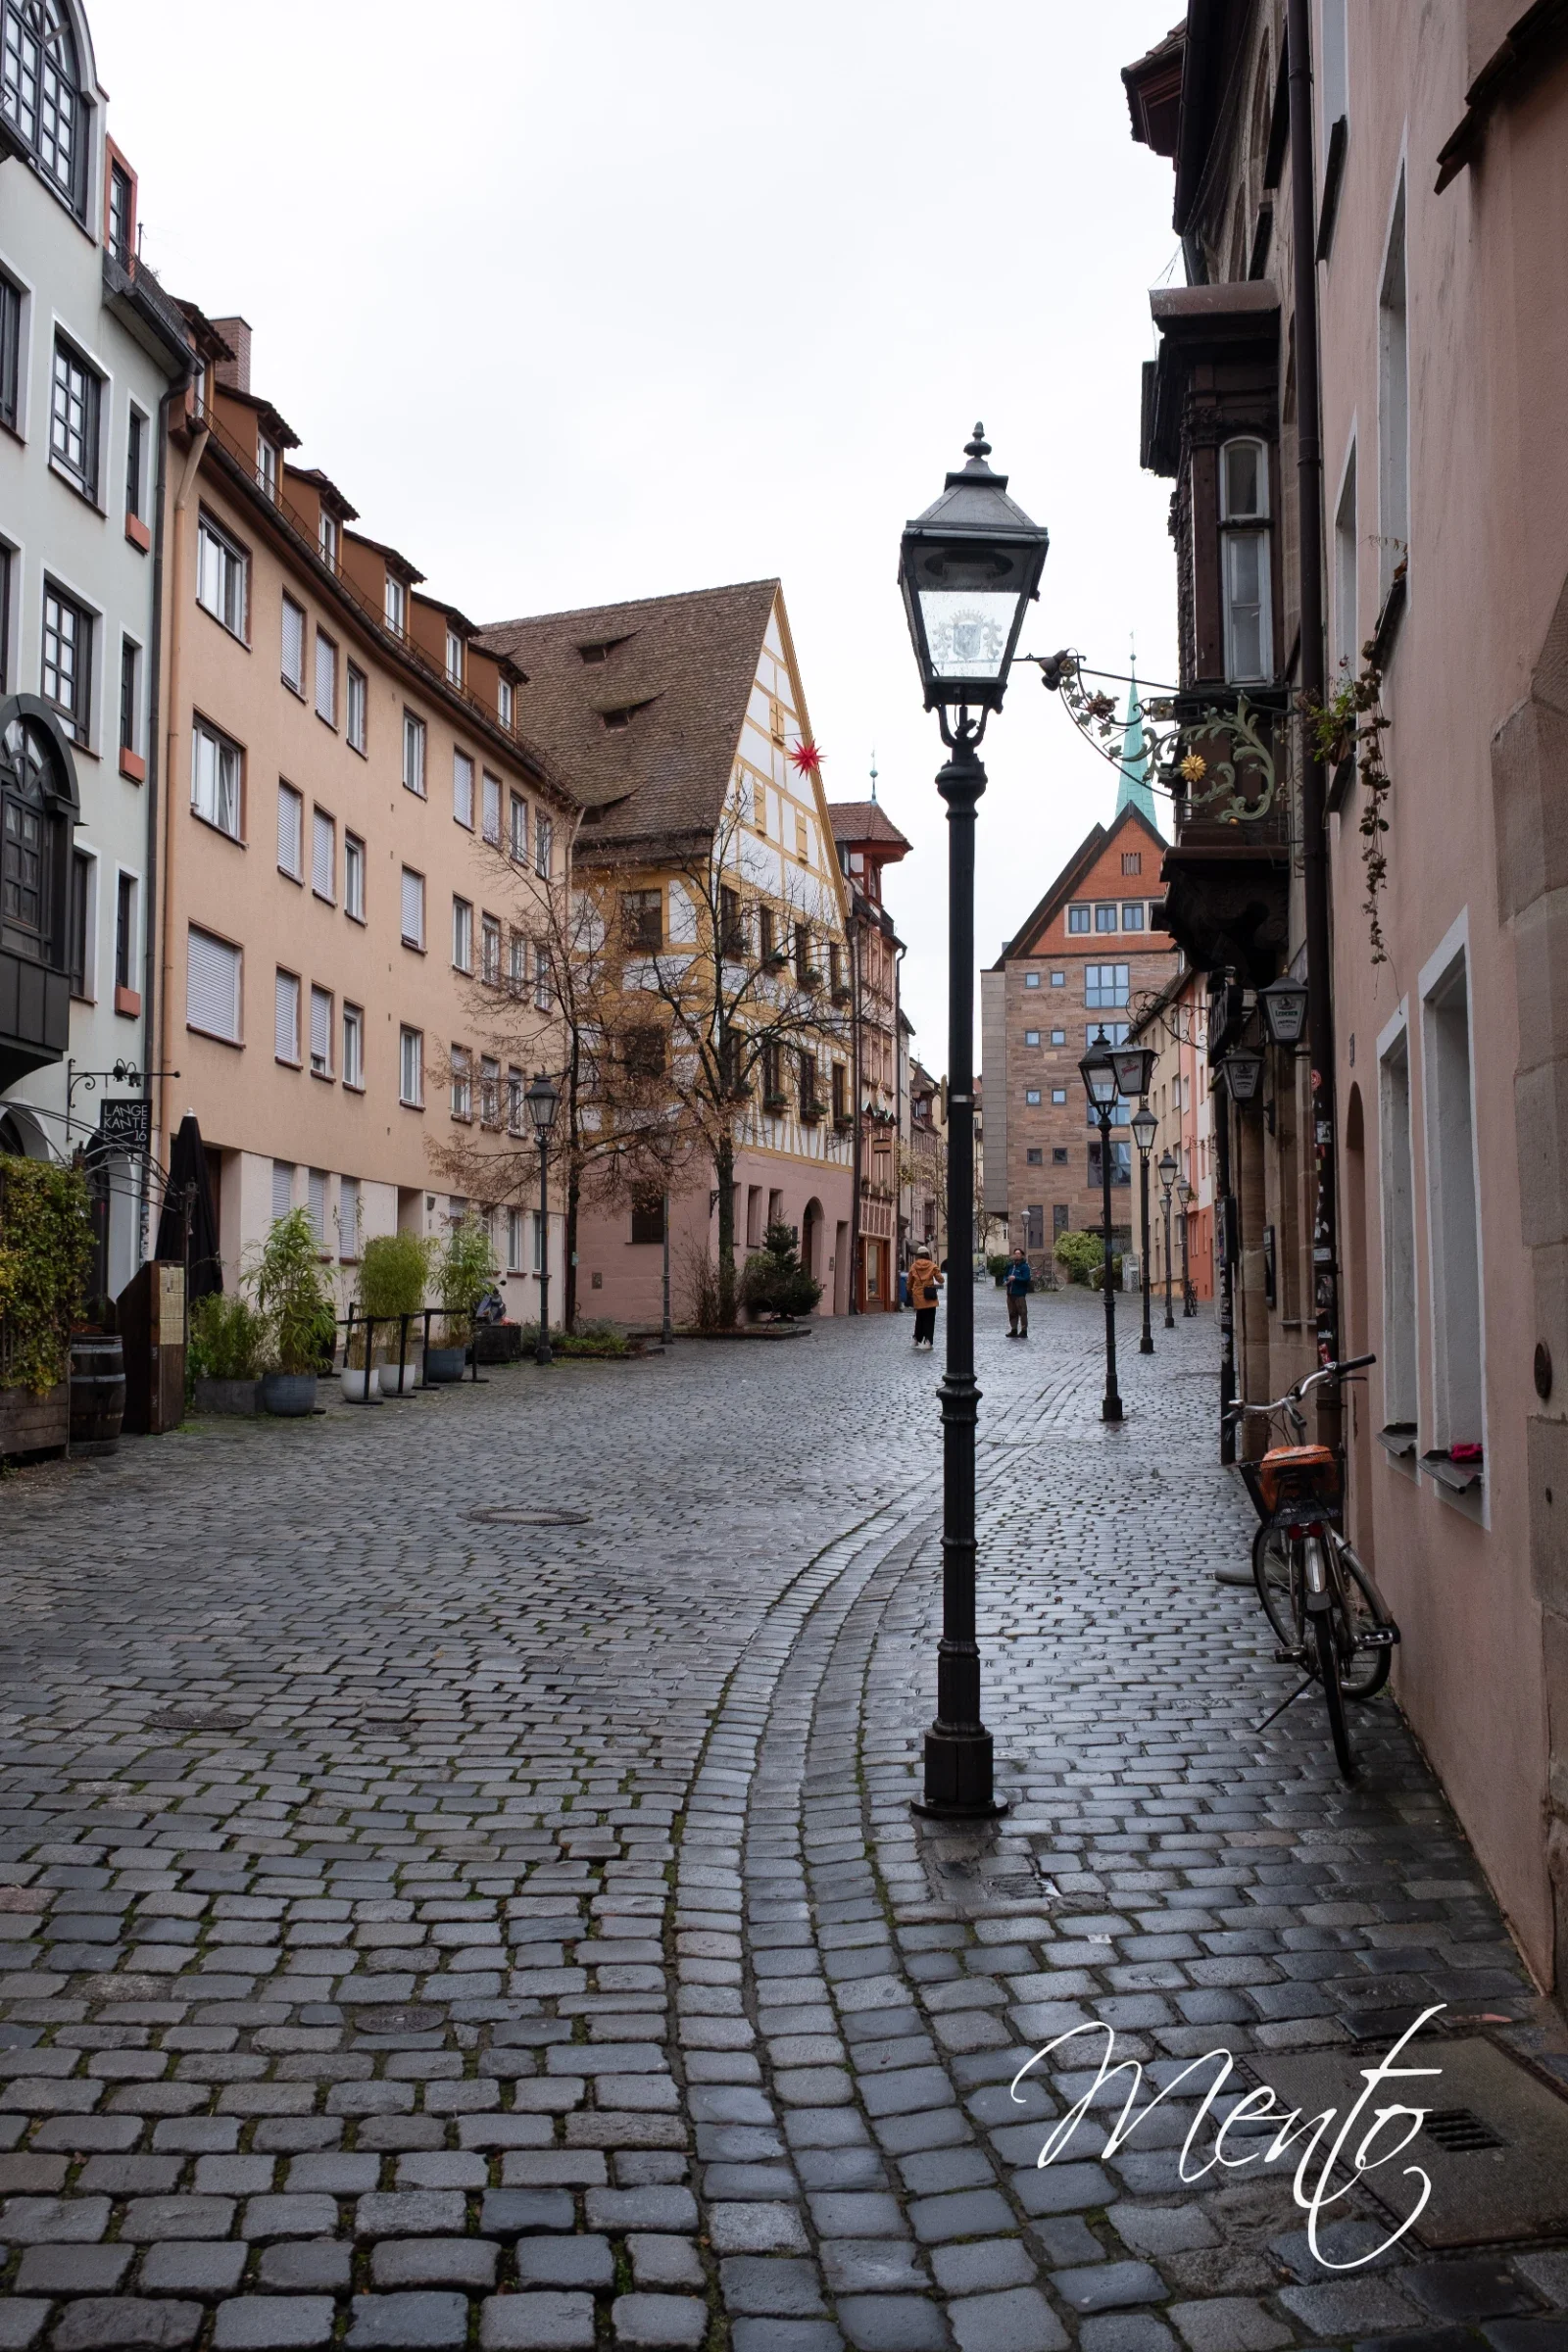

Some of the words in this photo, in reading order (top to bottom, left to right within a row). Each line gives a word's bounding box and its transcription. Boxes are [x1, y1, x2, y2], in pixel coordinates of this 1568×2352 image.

[104, 1103, 148, 1117] LANGE
[103, 1116, 148, 1130] KANTE
[134, 1129, 147, 1142] 16
